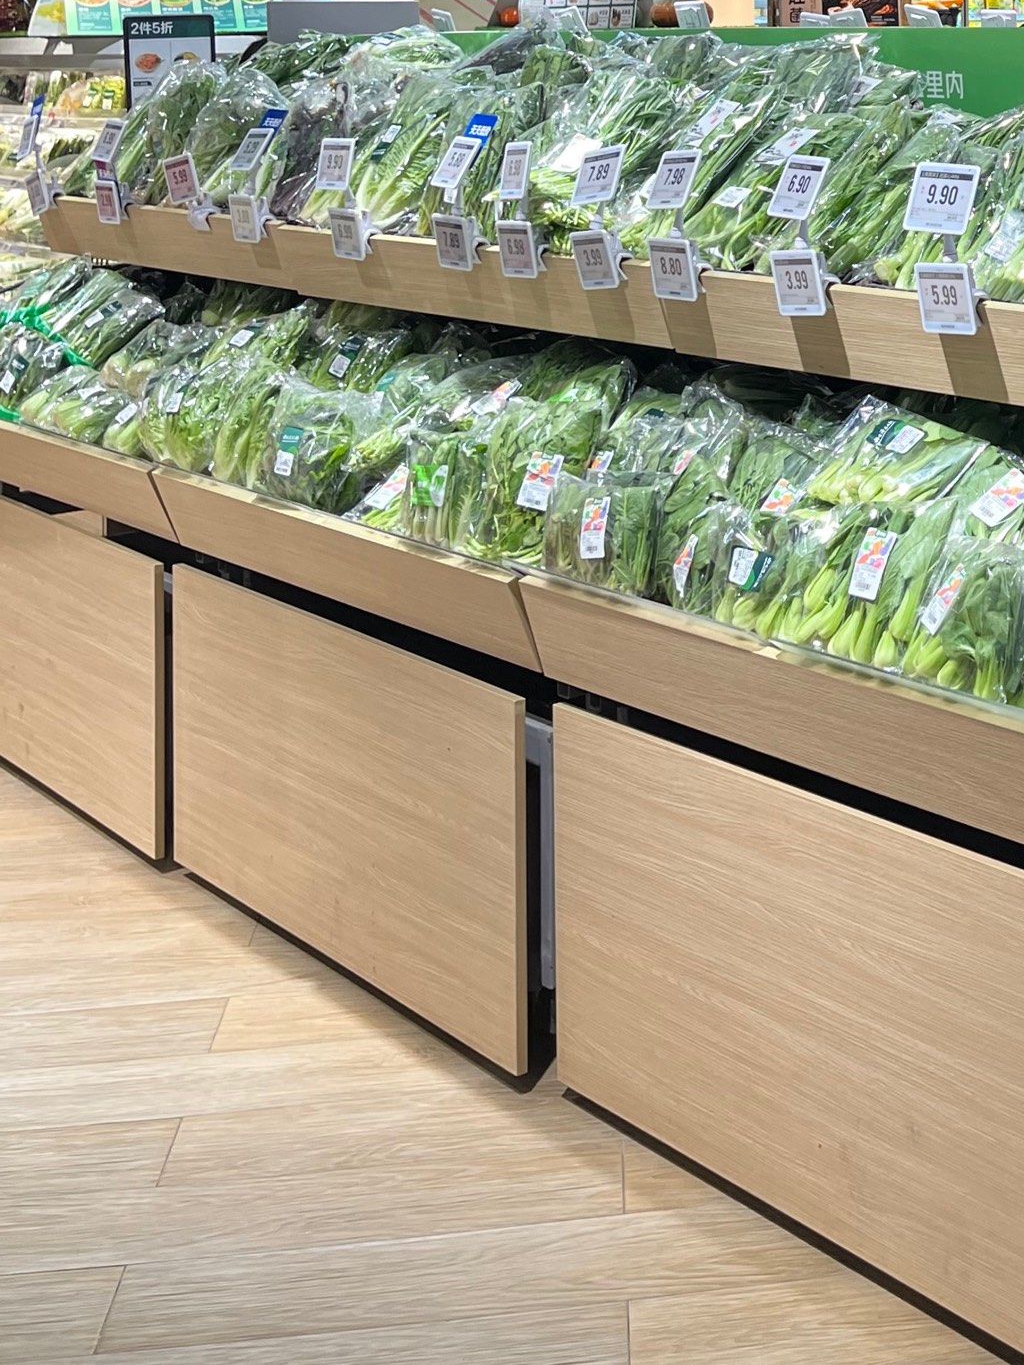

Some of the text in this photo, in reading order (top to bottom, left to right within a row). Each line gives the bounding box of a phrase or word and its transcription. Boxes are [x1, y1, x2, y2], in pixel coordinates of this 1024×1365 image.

[130, 21, 174, 34] 2件5折
[587, 163, 610, 183] 7.89
[664, 167, 686, 186] 7.98
[787, 174, 812, 195] 6.90
[926, 184, 959, 206] 9.90
[660, 256, 683, 276] 8.80
[785, 270, 809, 290] 3.99
[931, 284, 958, 306] 5.99
